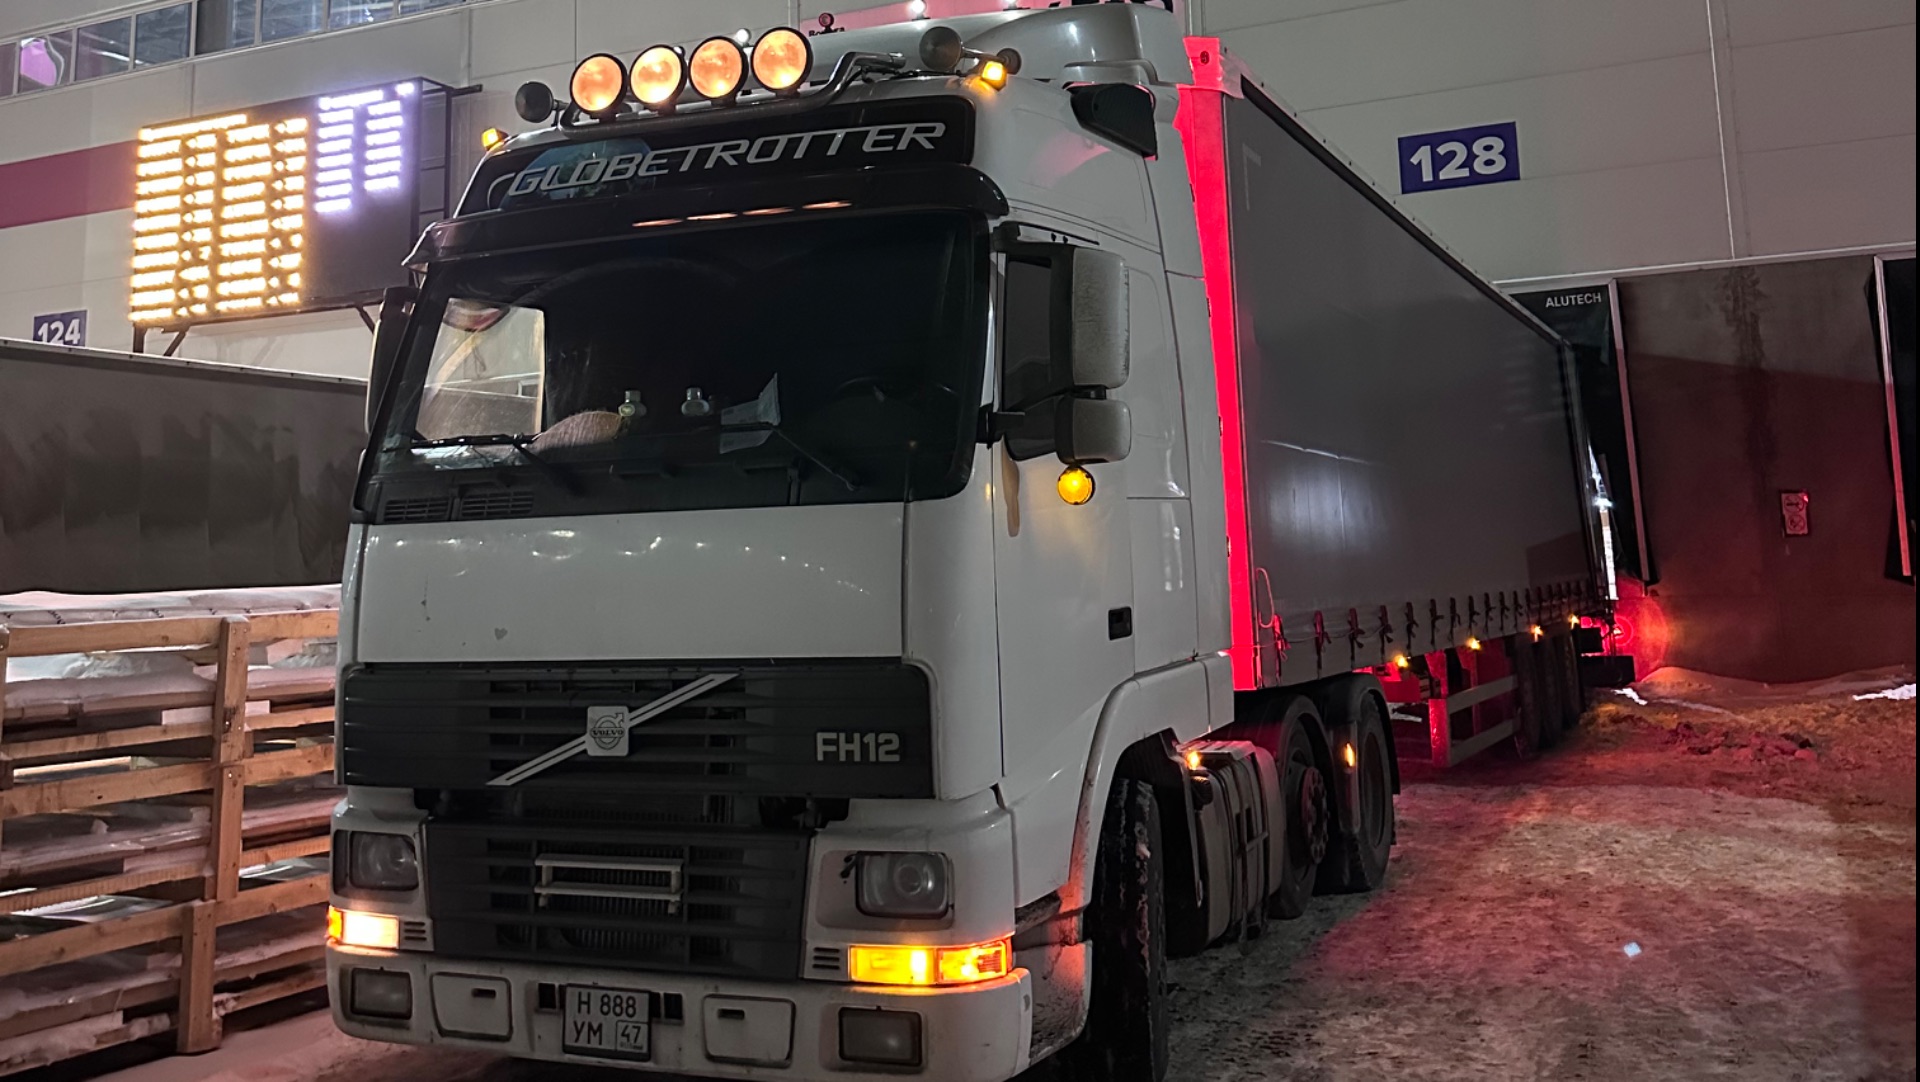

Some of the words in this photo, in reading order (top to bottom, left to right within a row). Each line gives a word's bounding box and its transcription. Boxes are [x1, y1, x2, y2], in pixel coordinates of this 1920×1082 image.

[508, 122, 946, 196] GLOBETROTTER
[1409, 136, 1507, 182] 128
[1545, 292, 1602, 308] ALUTECH
[37, 318, 81, 345] 124
[592, 729, 624, 737] VOLVO
[816, 732, 900, 762] FH12
[600, 993, 637, 1018] 888
[621, 1024, 642, 1044] 47
